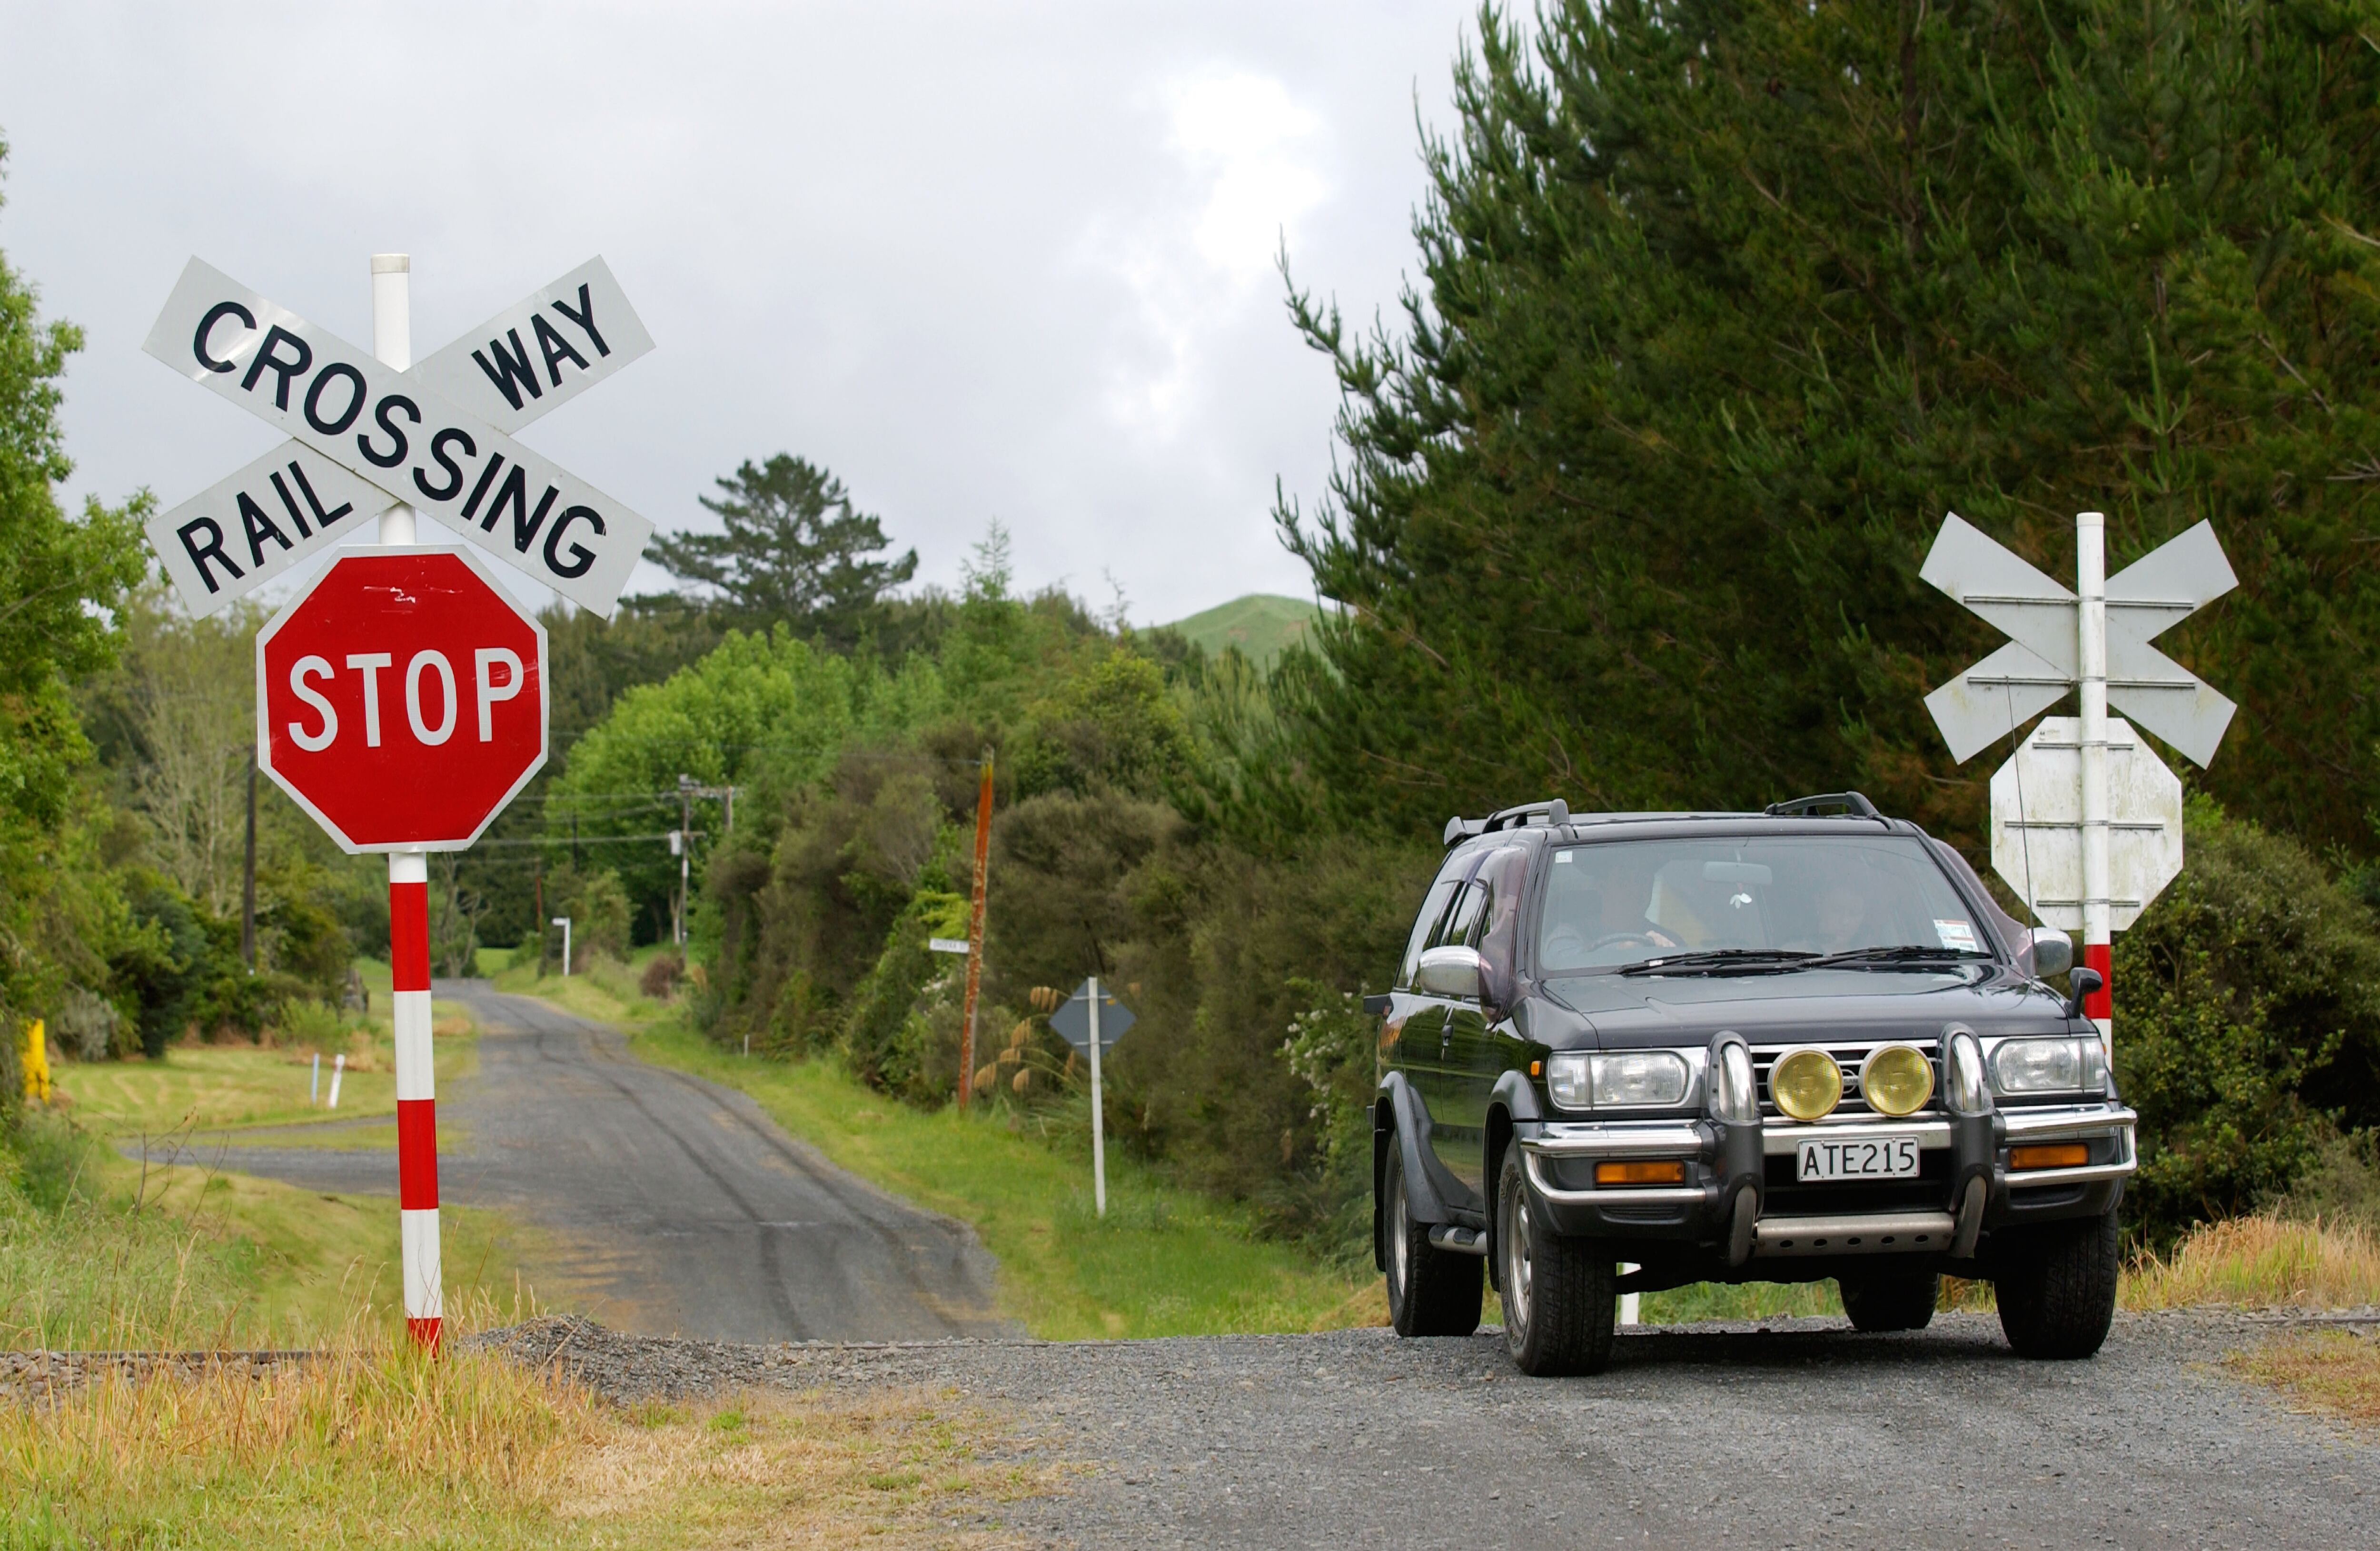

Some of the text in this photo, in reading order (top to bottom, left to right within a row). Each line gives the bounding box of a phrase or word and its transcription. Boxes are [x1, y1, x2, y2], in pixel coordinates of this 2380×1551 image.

[177, 283, 611, 594] RAIL WAY
[194, 301, 606, 579] CROSSING
[288, 647, 524, 752] STOP
[1803, 1142, 1915, 1176] ATE215
